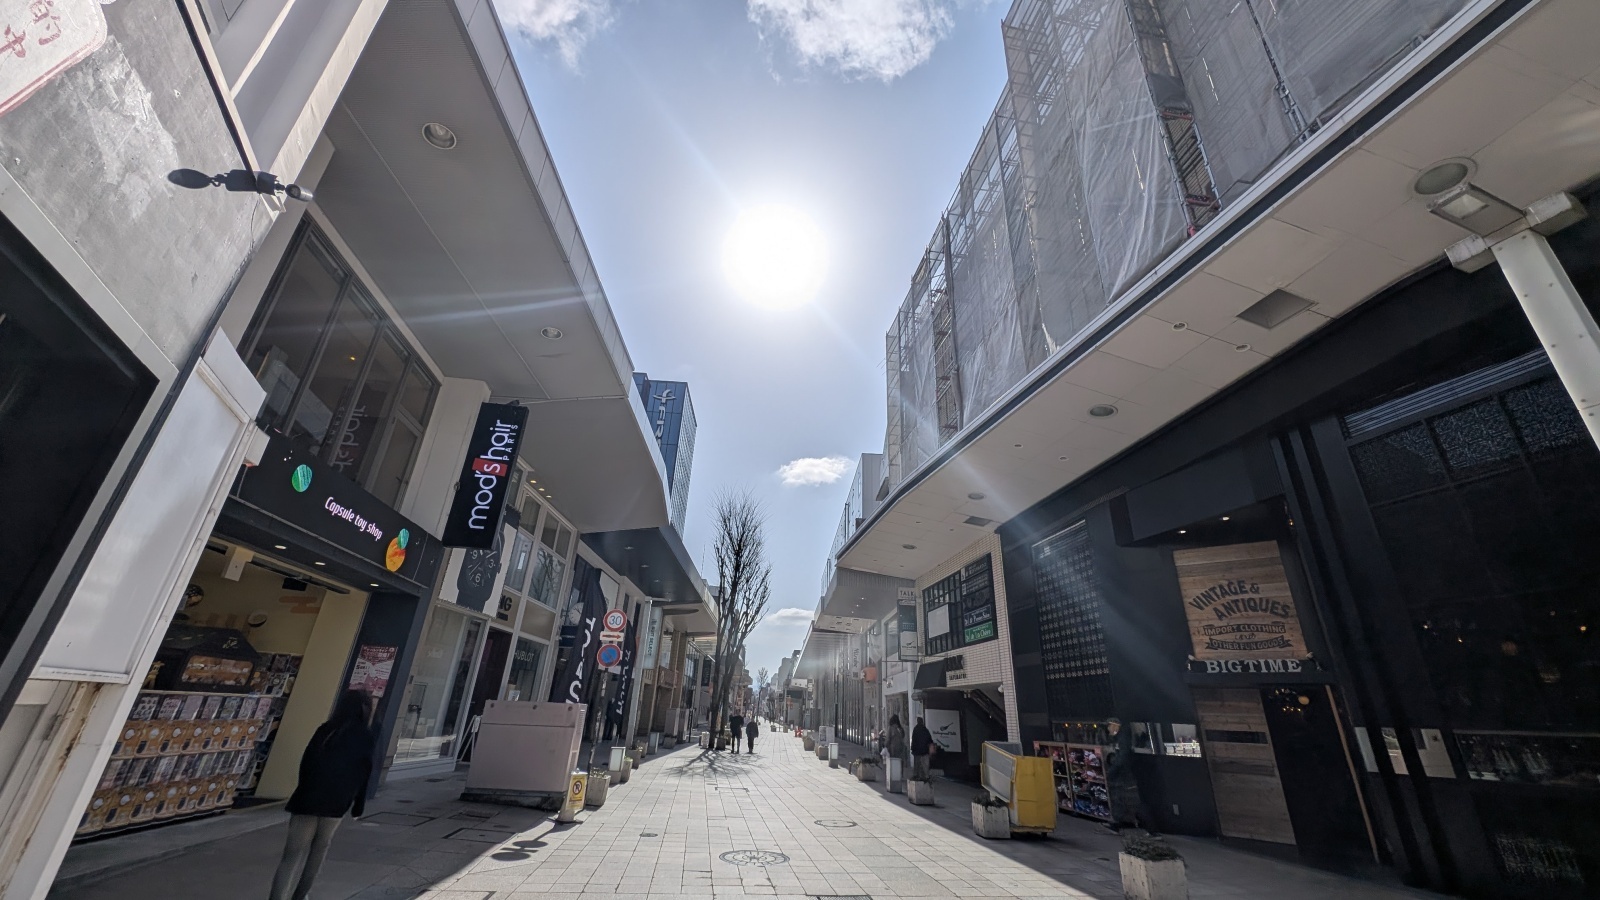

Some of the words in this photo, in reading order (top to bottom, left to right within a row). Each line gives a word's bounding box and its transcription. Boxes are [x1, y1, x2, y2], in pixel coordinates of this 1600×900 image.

[480, 420, 511, 460] hair
[502, 424, 519, 461] PARIS
[468, 463, 501, 530] mod's
[324, 496, 355, 522] Capsule
[354, 515, 367, 532] toy
[367, 523, 382, 541] shop
[1188, 580, 1248, 611] VINTAGE
[1249, 583, 1260, 594] &
[1212, 597, 1291, 621] ANTIQUES
[609, 615, 622, 626] 30
[1204, 624, 1238, 636] IMPORT
[1240, 624, 1285, 634] CLOTHING
[513, 650, 535, 663] HUBLOT
[1212, 640, 1239, 650] OTHER
[1240, 642, 1257, 650] FUN
[1257, 637, 1284, 650] GOODS
